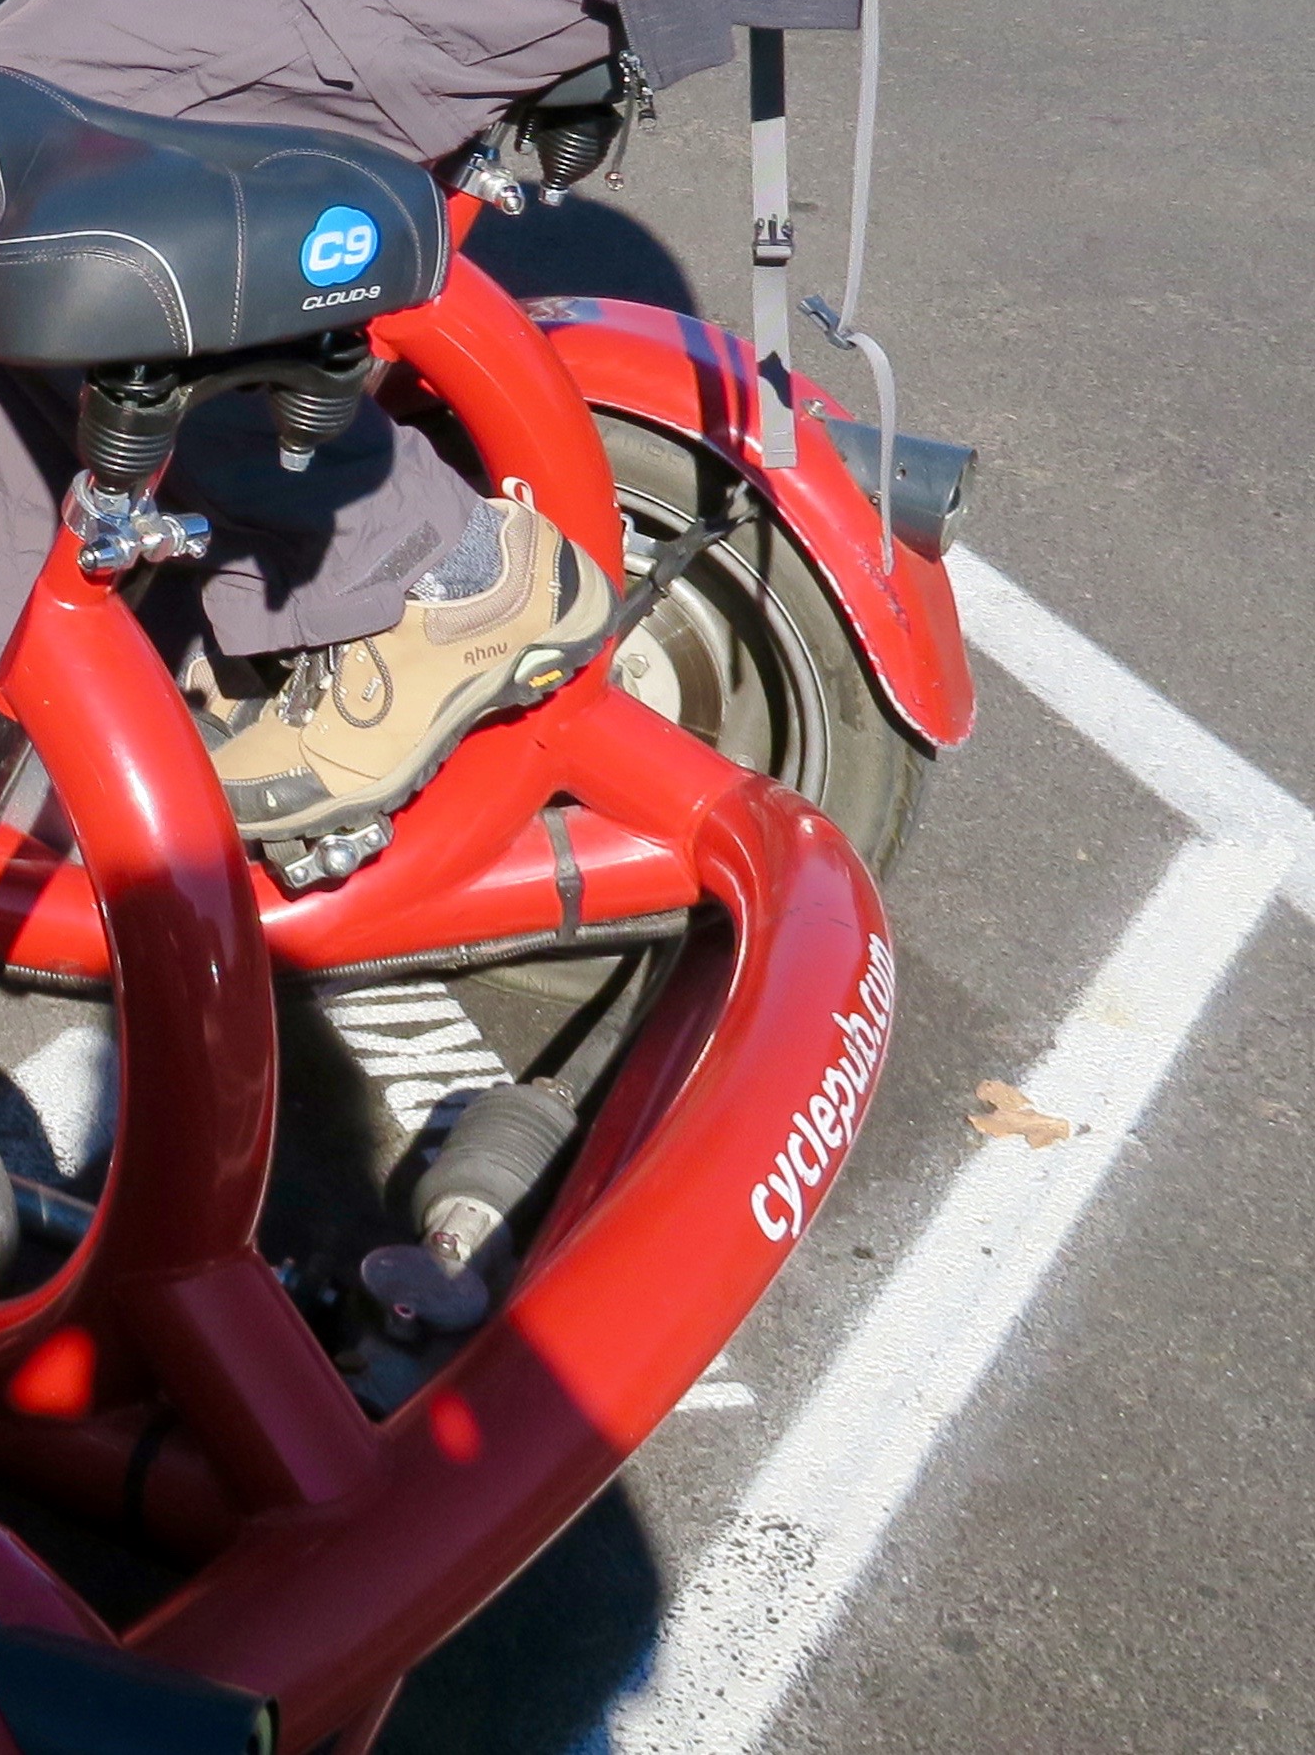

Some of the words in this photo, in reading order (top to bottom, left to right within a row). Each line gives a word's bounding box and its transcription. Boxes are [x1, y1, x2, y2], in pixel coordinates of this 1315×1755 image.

[308, 225, 372, 273] C9
[302, 285, 382, 312] CLOUD-9
[750, 932, 896, 1242] cyclepub.com
